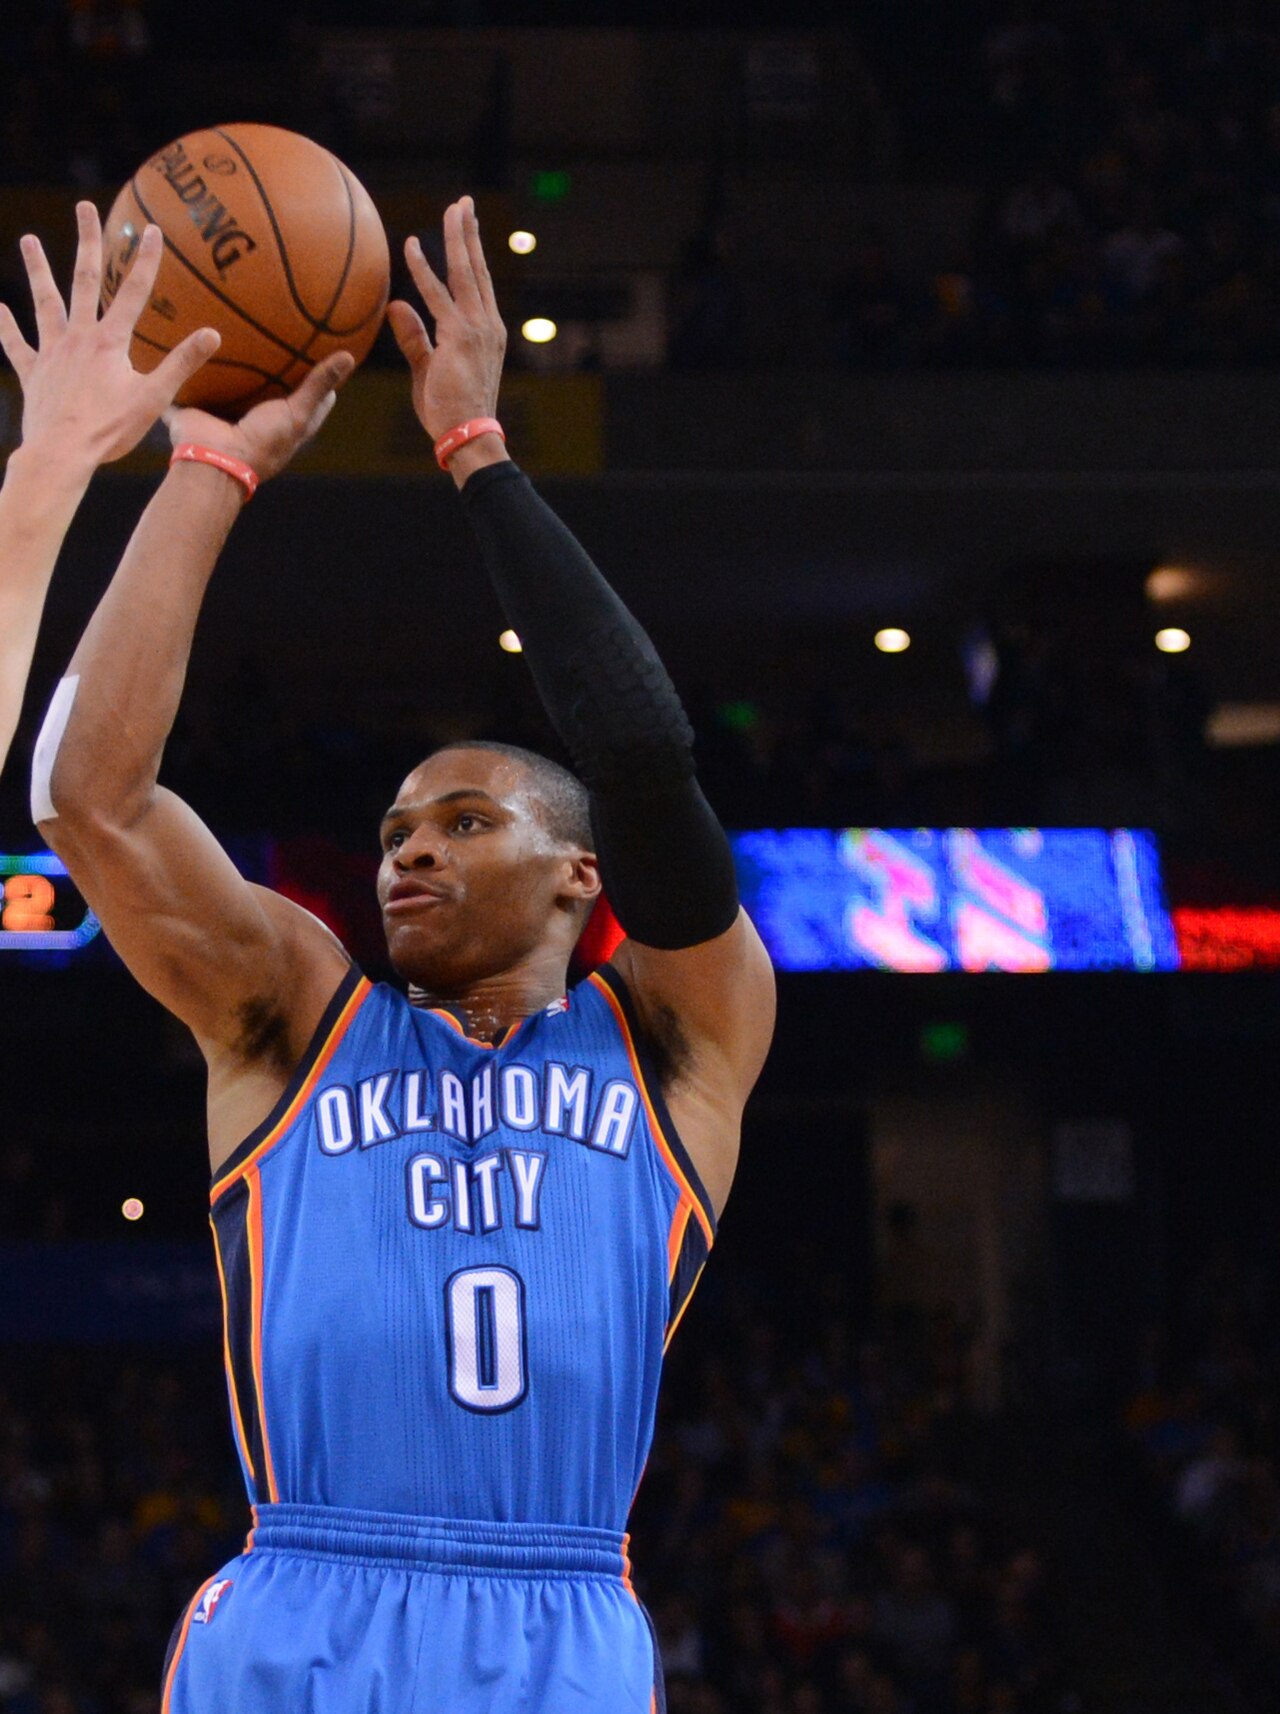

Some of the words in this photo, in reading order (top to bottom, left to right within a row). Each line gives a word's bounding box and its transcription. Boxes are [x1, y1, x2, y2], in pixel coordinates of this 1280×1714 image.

[2, 874, 56, 932] 2
[315, 1060, 639, 1160] OKLAHOMA
[404, 1150, 548, 1236] CITY
[442, 1262, 530, 1416] 0
